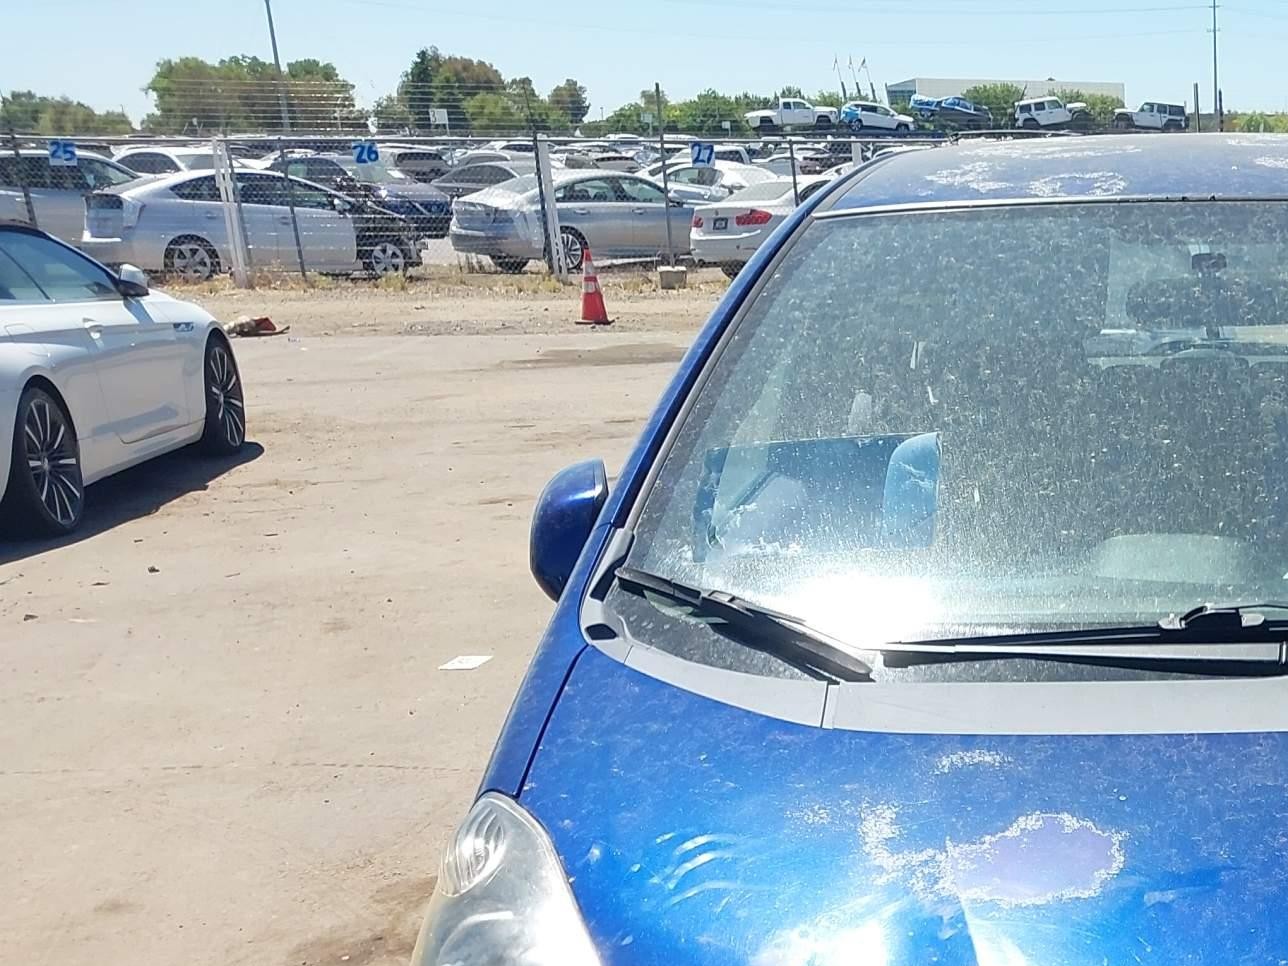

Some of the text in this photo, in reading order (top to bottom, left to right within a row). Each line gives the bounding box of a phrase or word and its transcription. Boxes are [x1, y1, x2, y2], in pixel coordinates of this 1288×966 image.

[50, 141, 76, 161] 25
[352, 142, 379, 163] 26
[691, 143, 714, 164] 27
